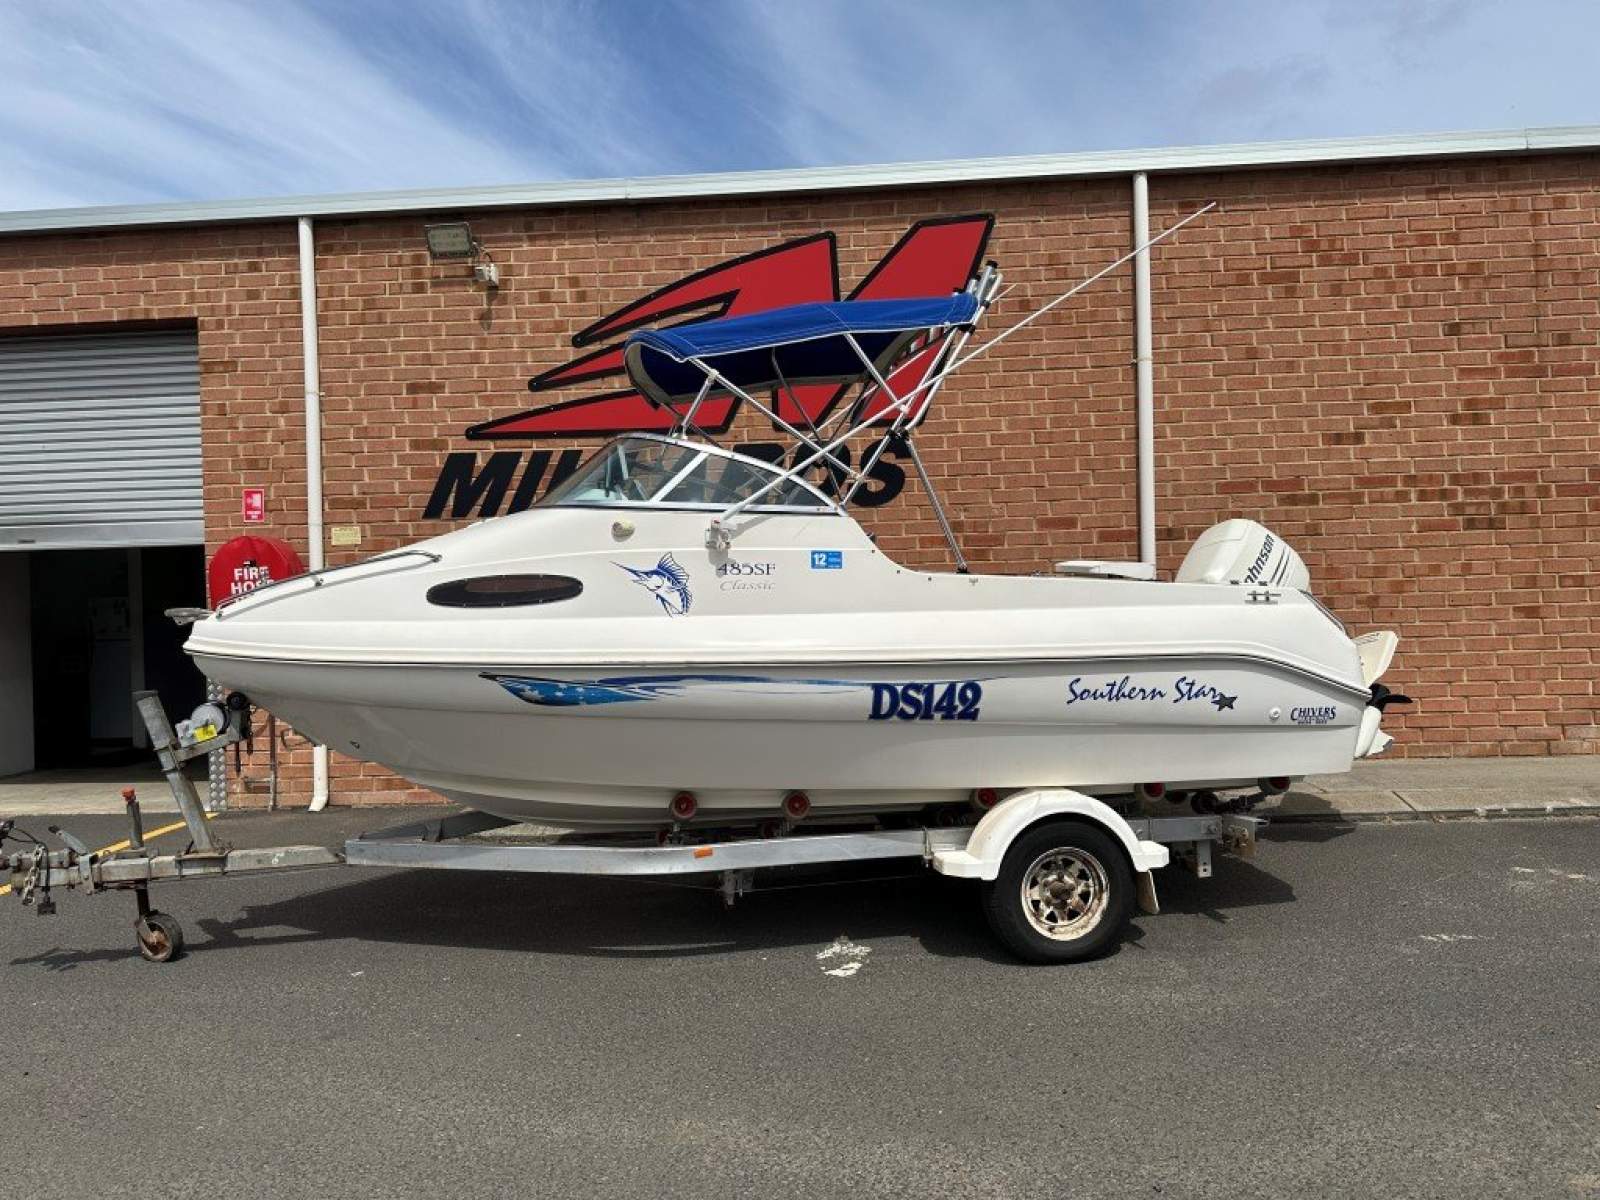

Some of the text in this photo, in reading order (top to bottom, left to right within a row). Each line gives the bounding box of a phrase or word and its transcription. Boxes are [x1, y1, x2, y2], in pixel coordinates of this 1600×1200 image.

[719, 580, 777, 591] Classic
[868, 680, 982, 721] DS142
[1066, 675, 1220, 705] Southern Star
[1290, 705, 1337, 721] CHIVERS
